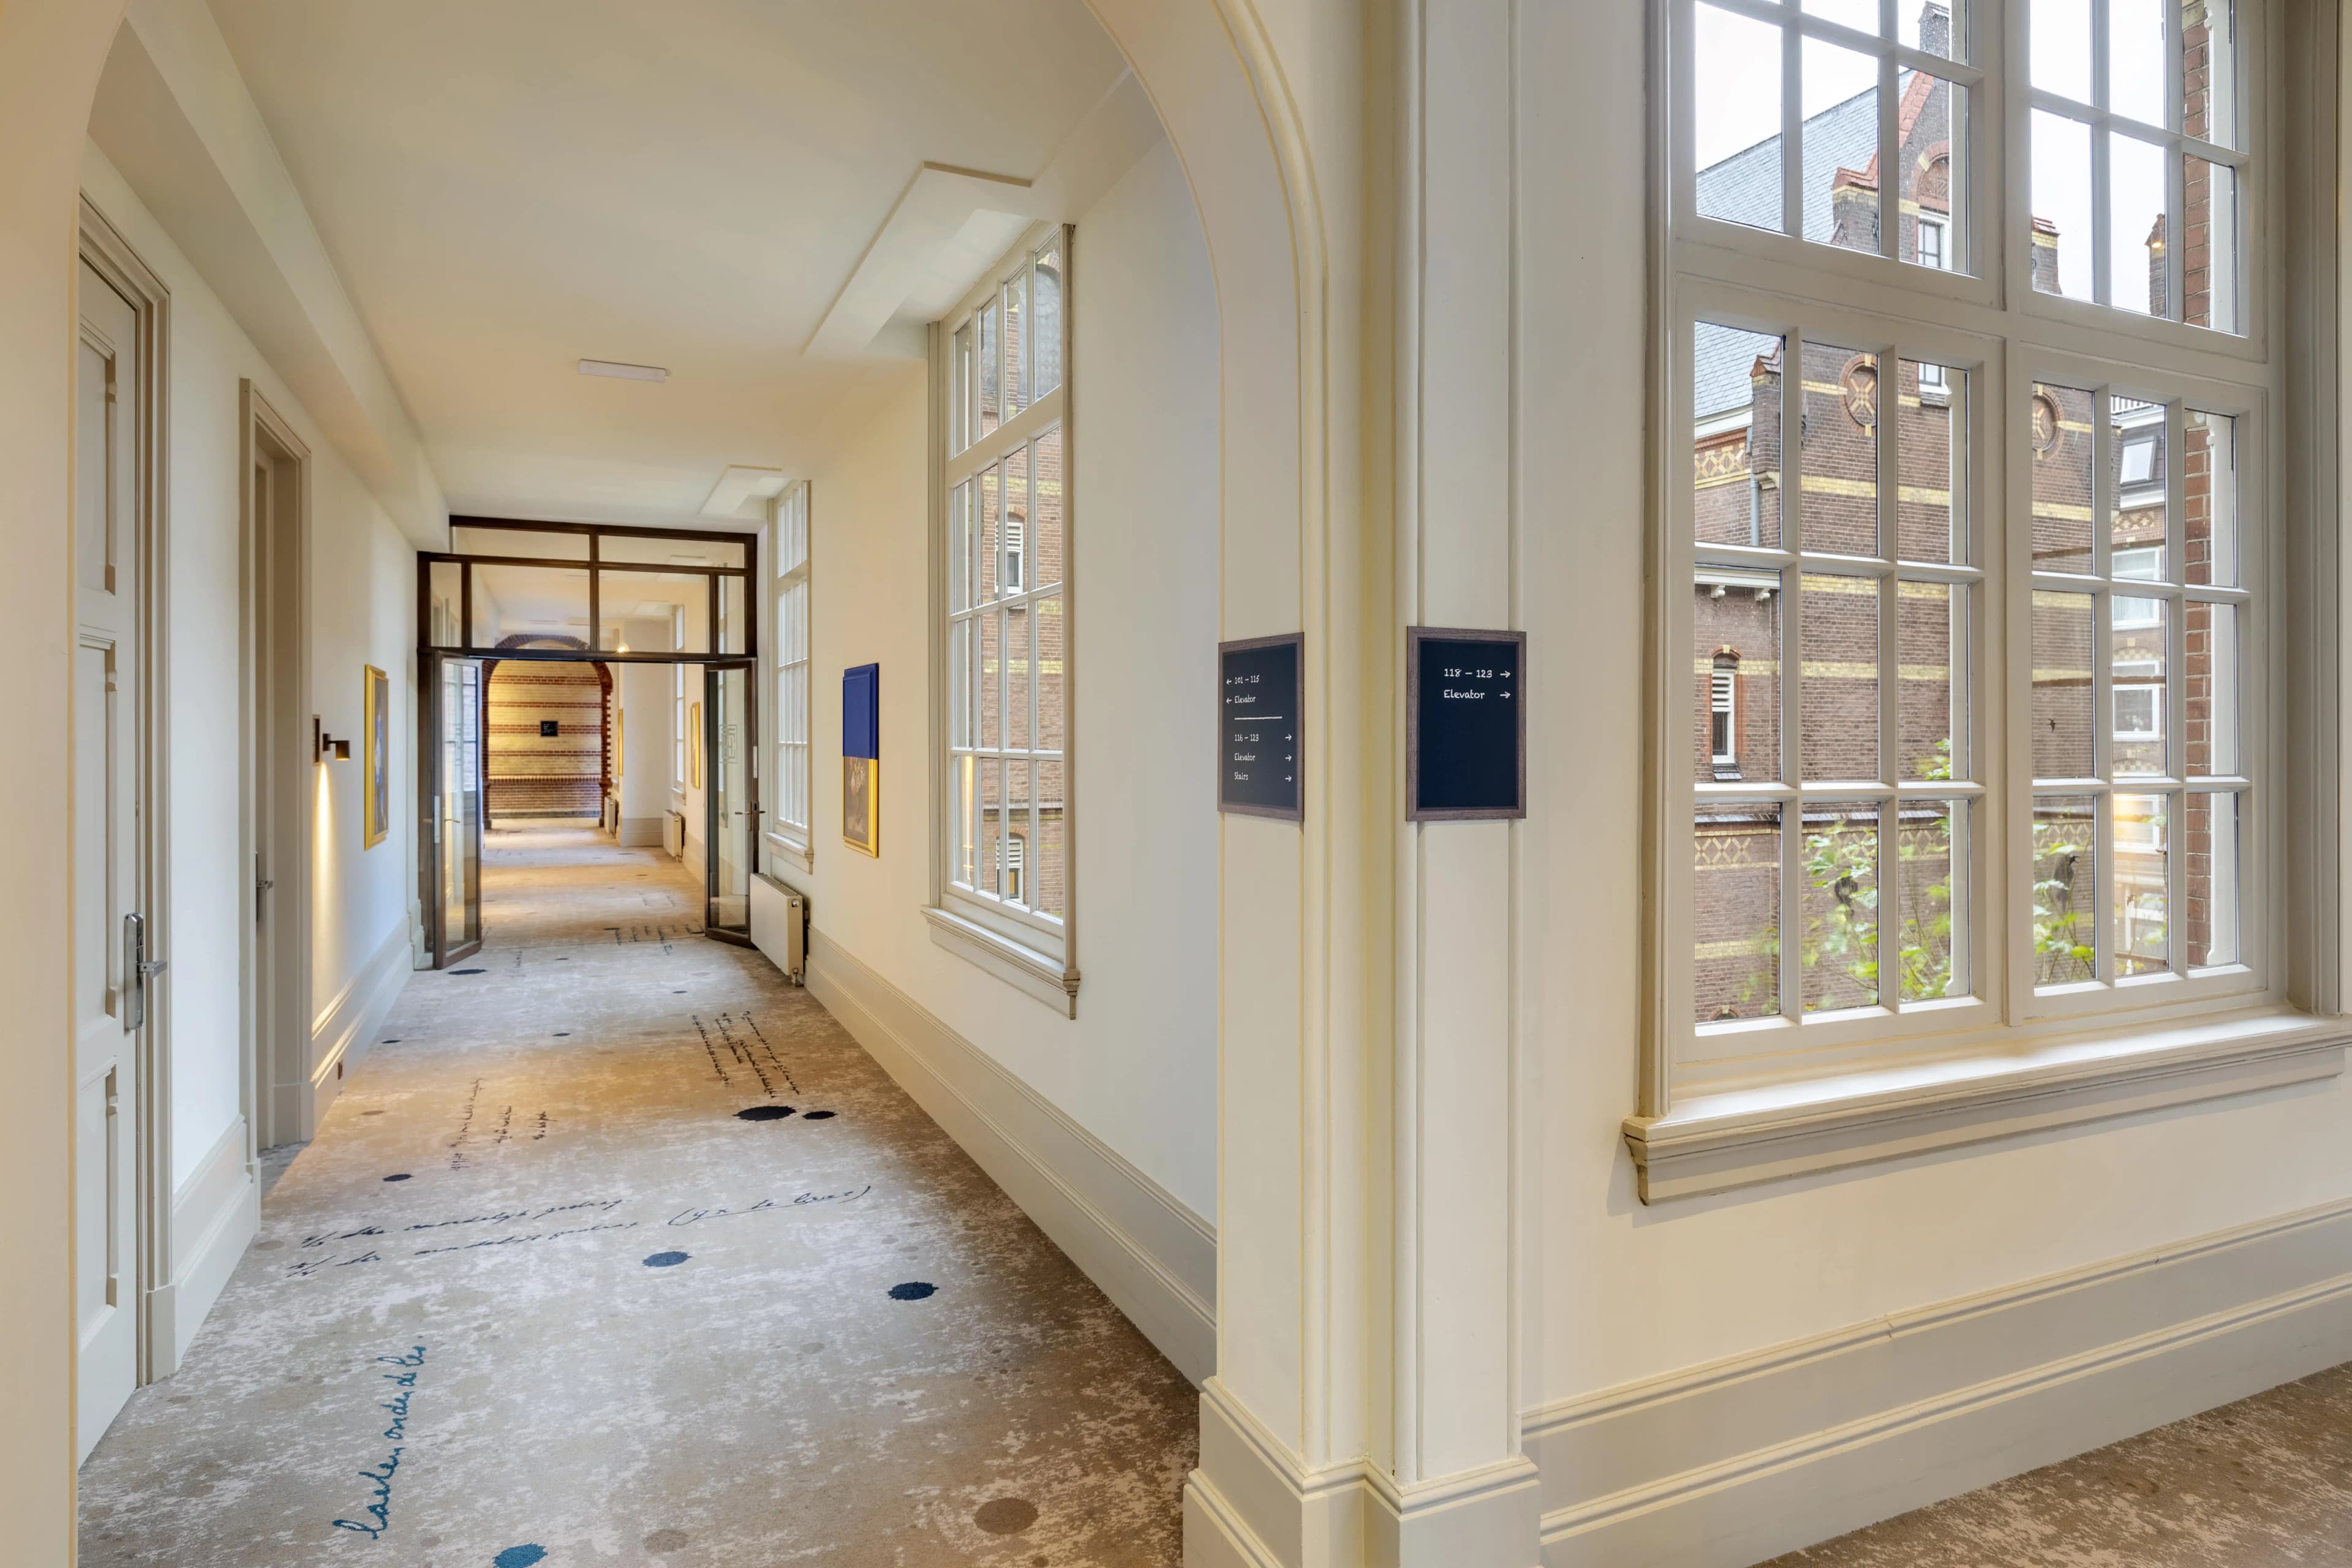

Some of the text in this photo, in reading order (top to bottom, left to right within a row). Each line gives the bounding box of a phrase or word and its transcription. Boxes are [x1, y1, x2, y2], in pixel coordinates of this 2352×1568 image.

[1444, 668, 1462, 677] 118
[1476, 669, 1493, 679] 123
[1234, 676, 1243, 685] 101
[1250, 674, 1260, 684] 115
[1234, 693, 1256, 704] Elevator
[1444, 688, 1485, 699] Elevator
[1250, 733, 1259, 742] 123
[1234, 752, 1256, 761] Elevator
[1234, 771, 1249, 781] Stairs
